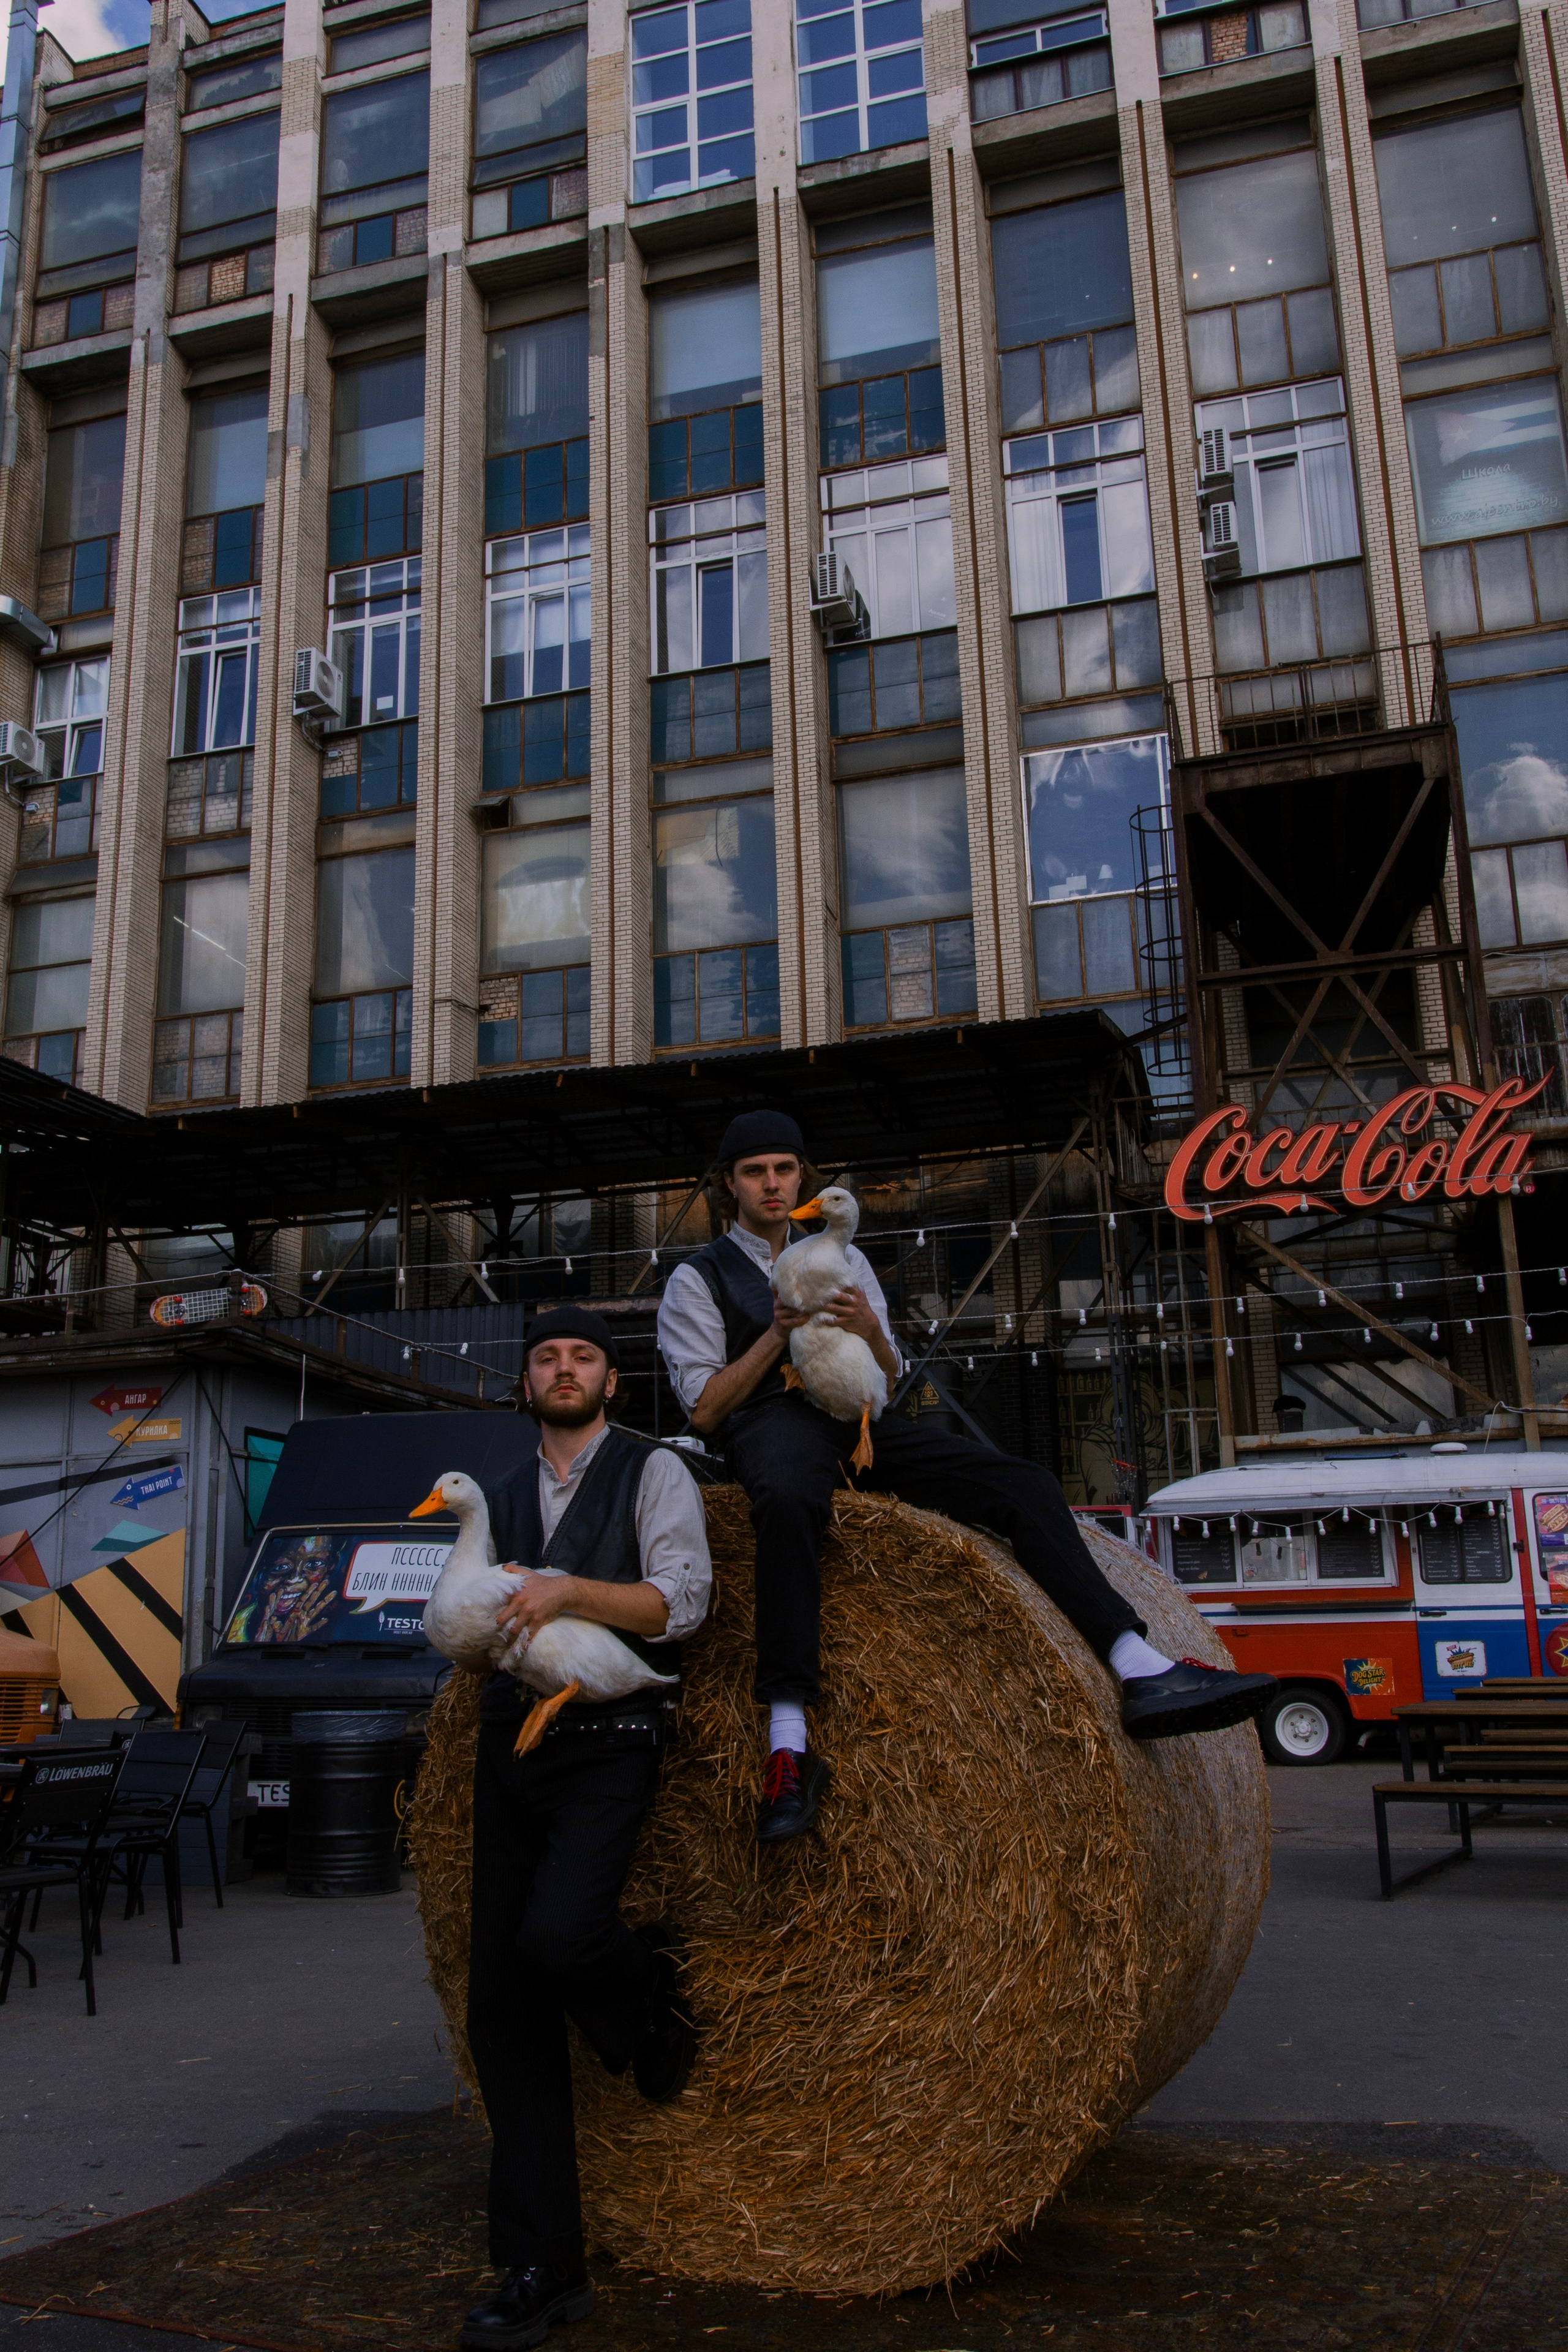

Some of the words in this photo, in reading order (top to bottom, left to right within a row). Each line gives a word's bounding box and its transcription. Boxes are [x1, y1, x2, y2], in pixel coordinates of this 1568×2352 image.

[1461, 464, 1511, 481] Школа
[1165, 1066, 1555, 1221] Coca-Cola
[124, 1393, 146, 1404] АНГАР
[136, 1425, 168, 1436] КУРИЛКА
[140, 1483, 155, 1494] THAI
[156, 1476, 173, 1490] POINT
[352, 1572, 388, 1591] БЛИН
[1351, 1670, 1367, 1683] DOG
[1367, 1667, 1385, 1678] STAR
[1358, 1677, 1382, 1687] DELIGHT
[48, 1762, 114, 1782] LÖWENBRÄU
